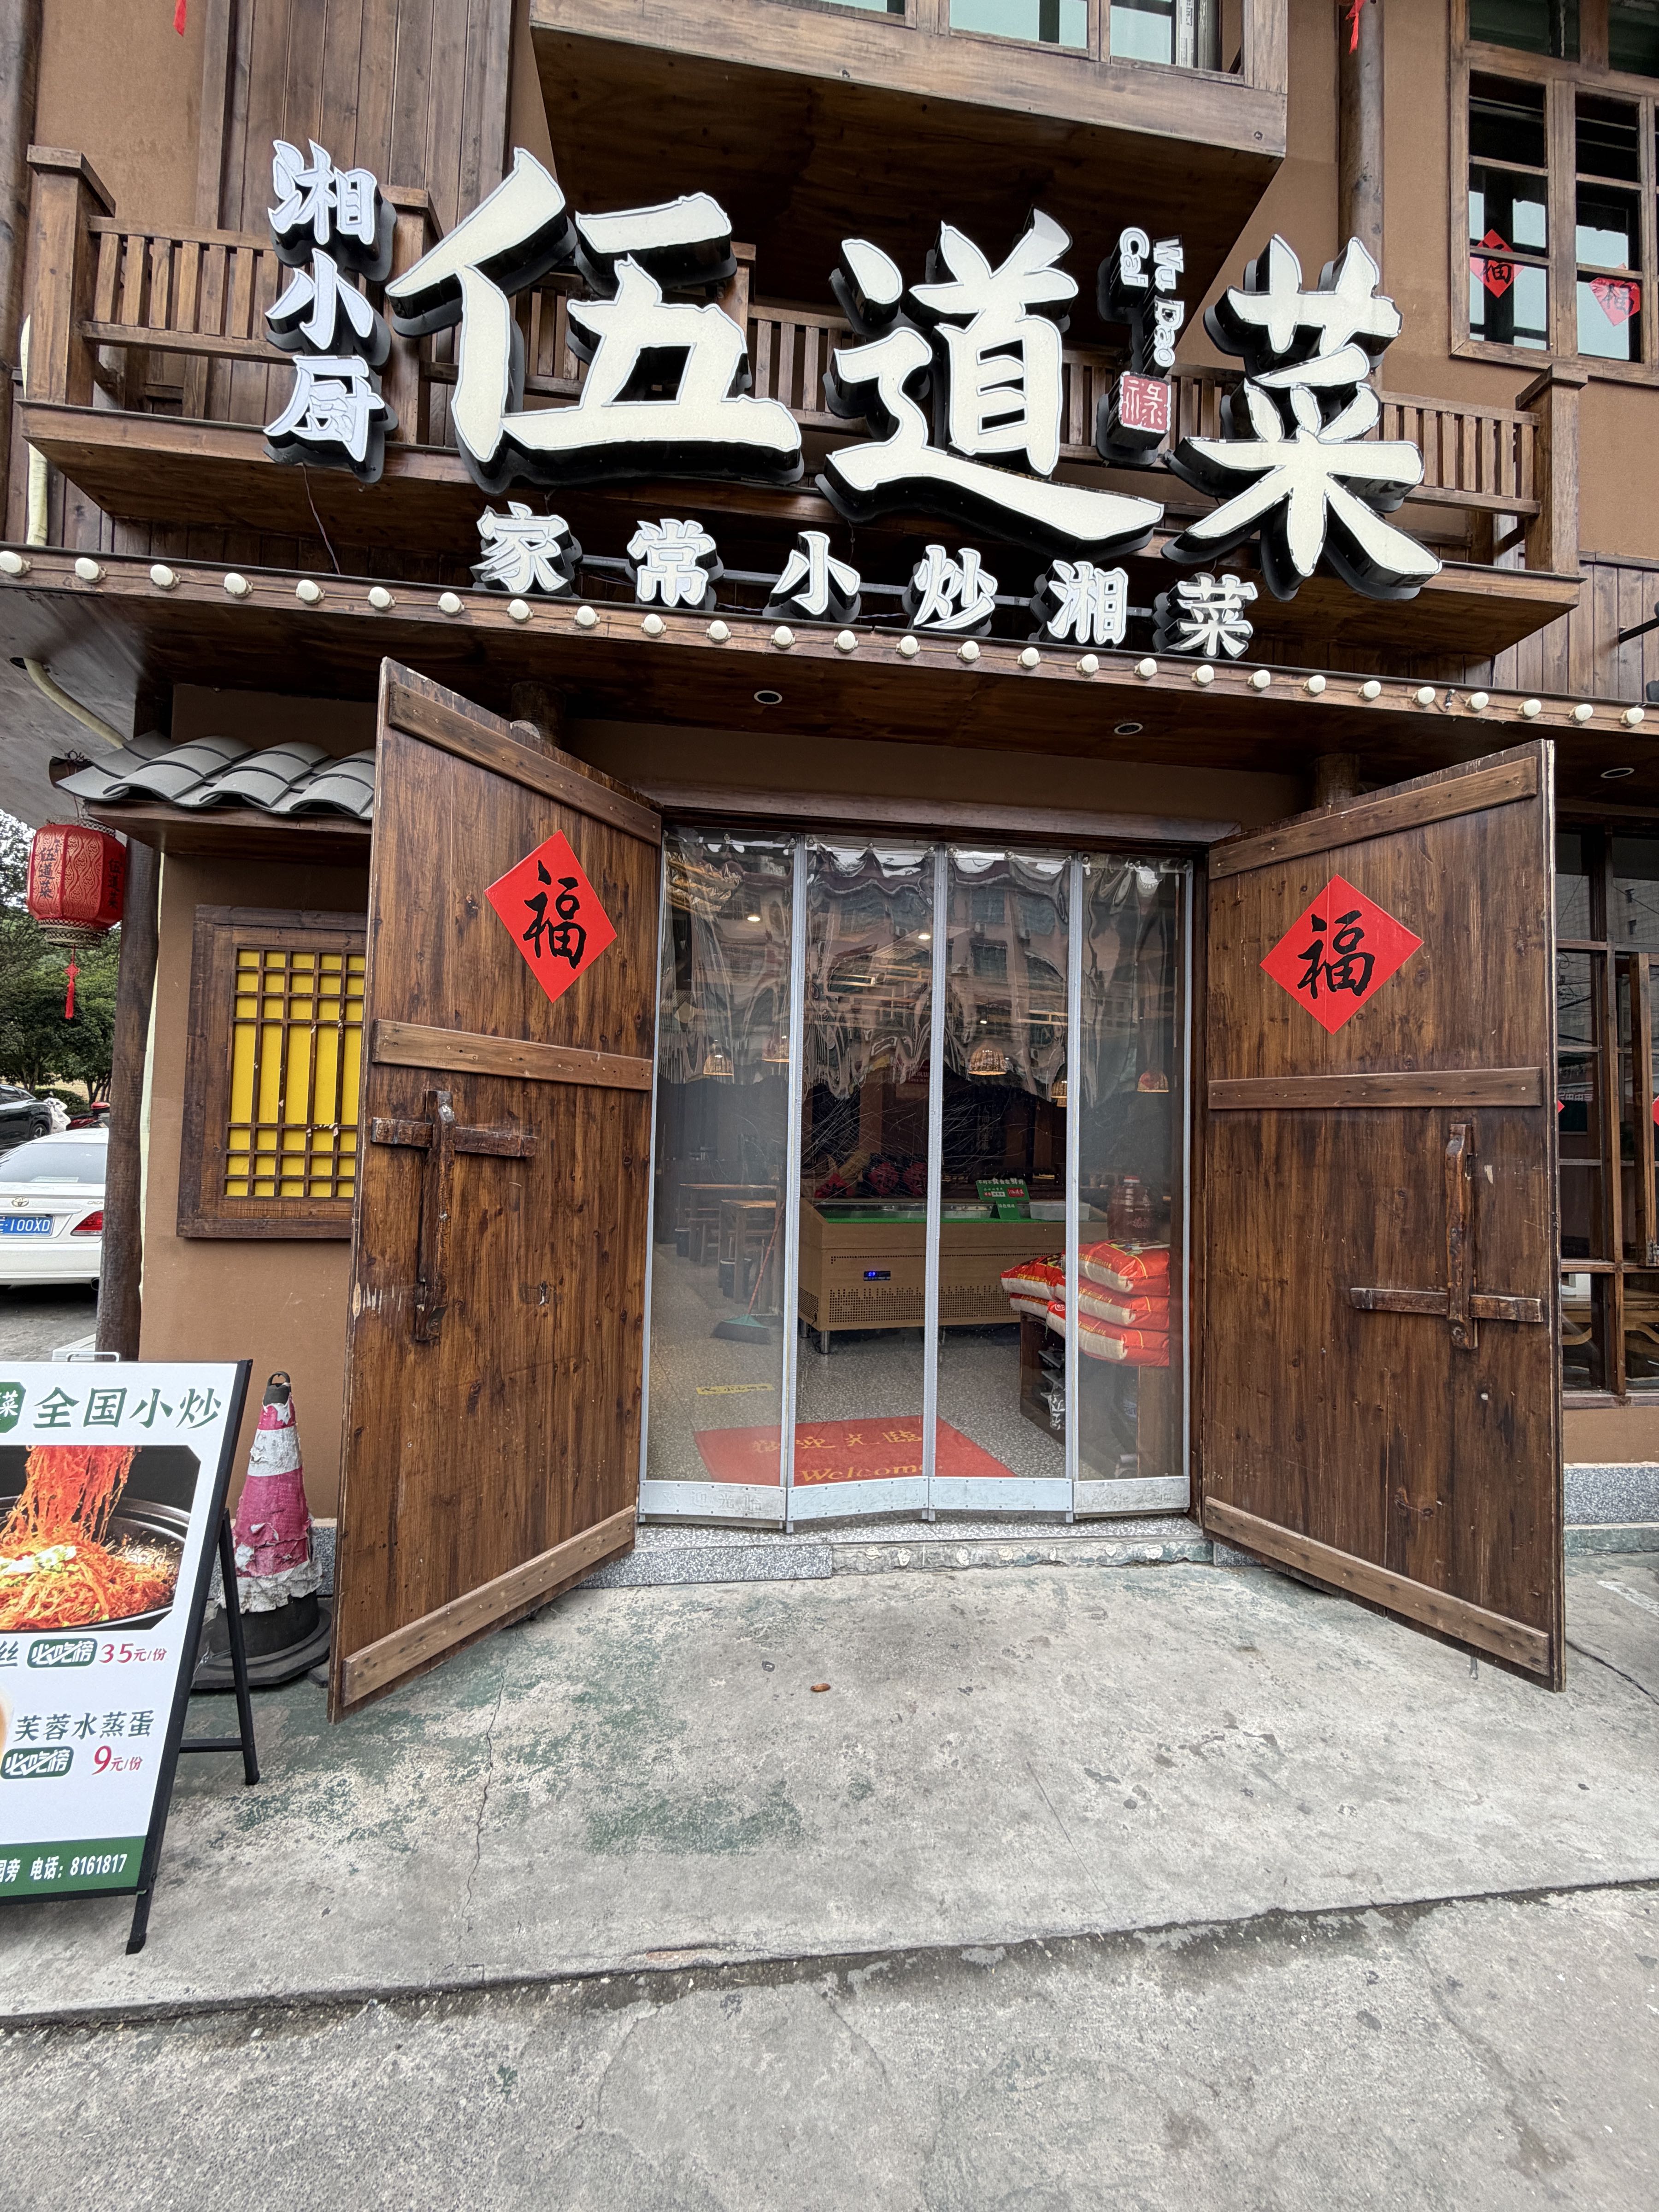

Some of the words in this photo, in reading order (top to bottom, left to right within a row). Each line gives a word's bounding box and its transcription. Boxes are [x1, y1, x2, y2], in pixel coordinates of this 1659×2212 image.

[1119, 227, 1150, 288] Cai
[1153, 235, 1184, 292] Wu
[264, 139, 385, 462] 湘小厨
[1153, 295, 1184, 368] Dao
[386, 147, 1443, 577] 伍道菜
[477, 502, 1258, 659] 家常小炒湘菜
[523, 859, 587, 969] 福
[1296, 910, 1376, 1000] 福
[0, 1389, 18, 1418] 菜
[33, 1387, 222, 1430] 全国小炒
[800, 1465, 923, 1482] Welcom
[30, 1642, 94, 1665] 必吃榜
[99, 1643, 167, 1664] 35元/份
[13, 1710, 154, 1742] 芙蓉水蒸蛋
[4, 1749, 71, 1776] 必吃榜
[92, 1745, 143, 1775] 9元/份
[70, 1854, 128, 1876] 8161817
